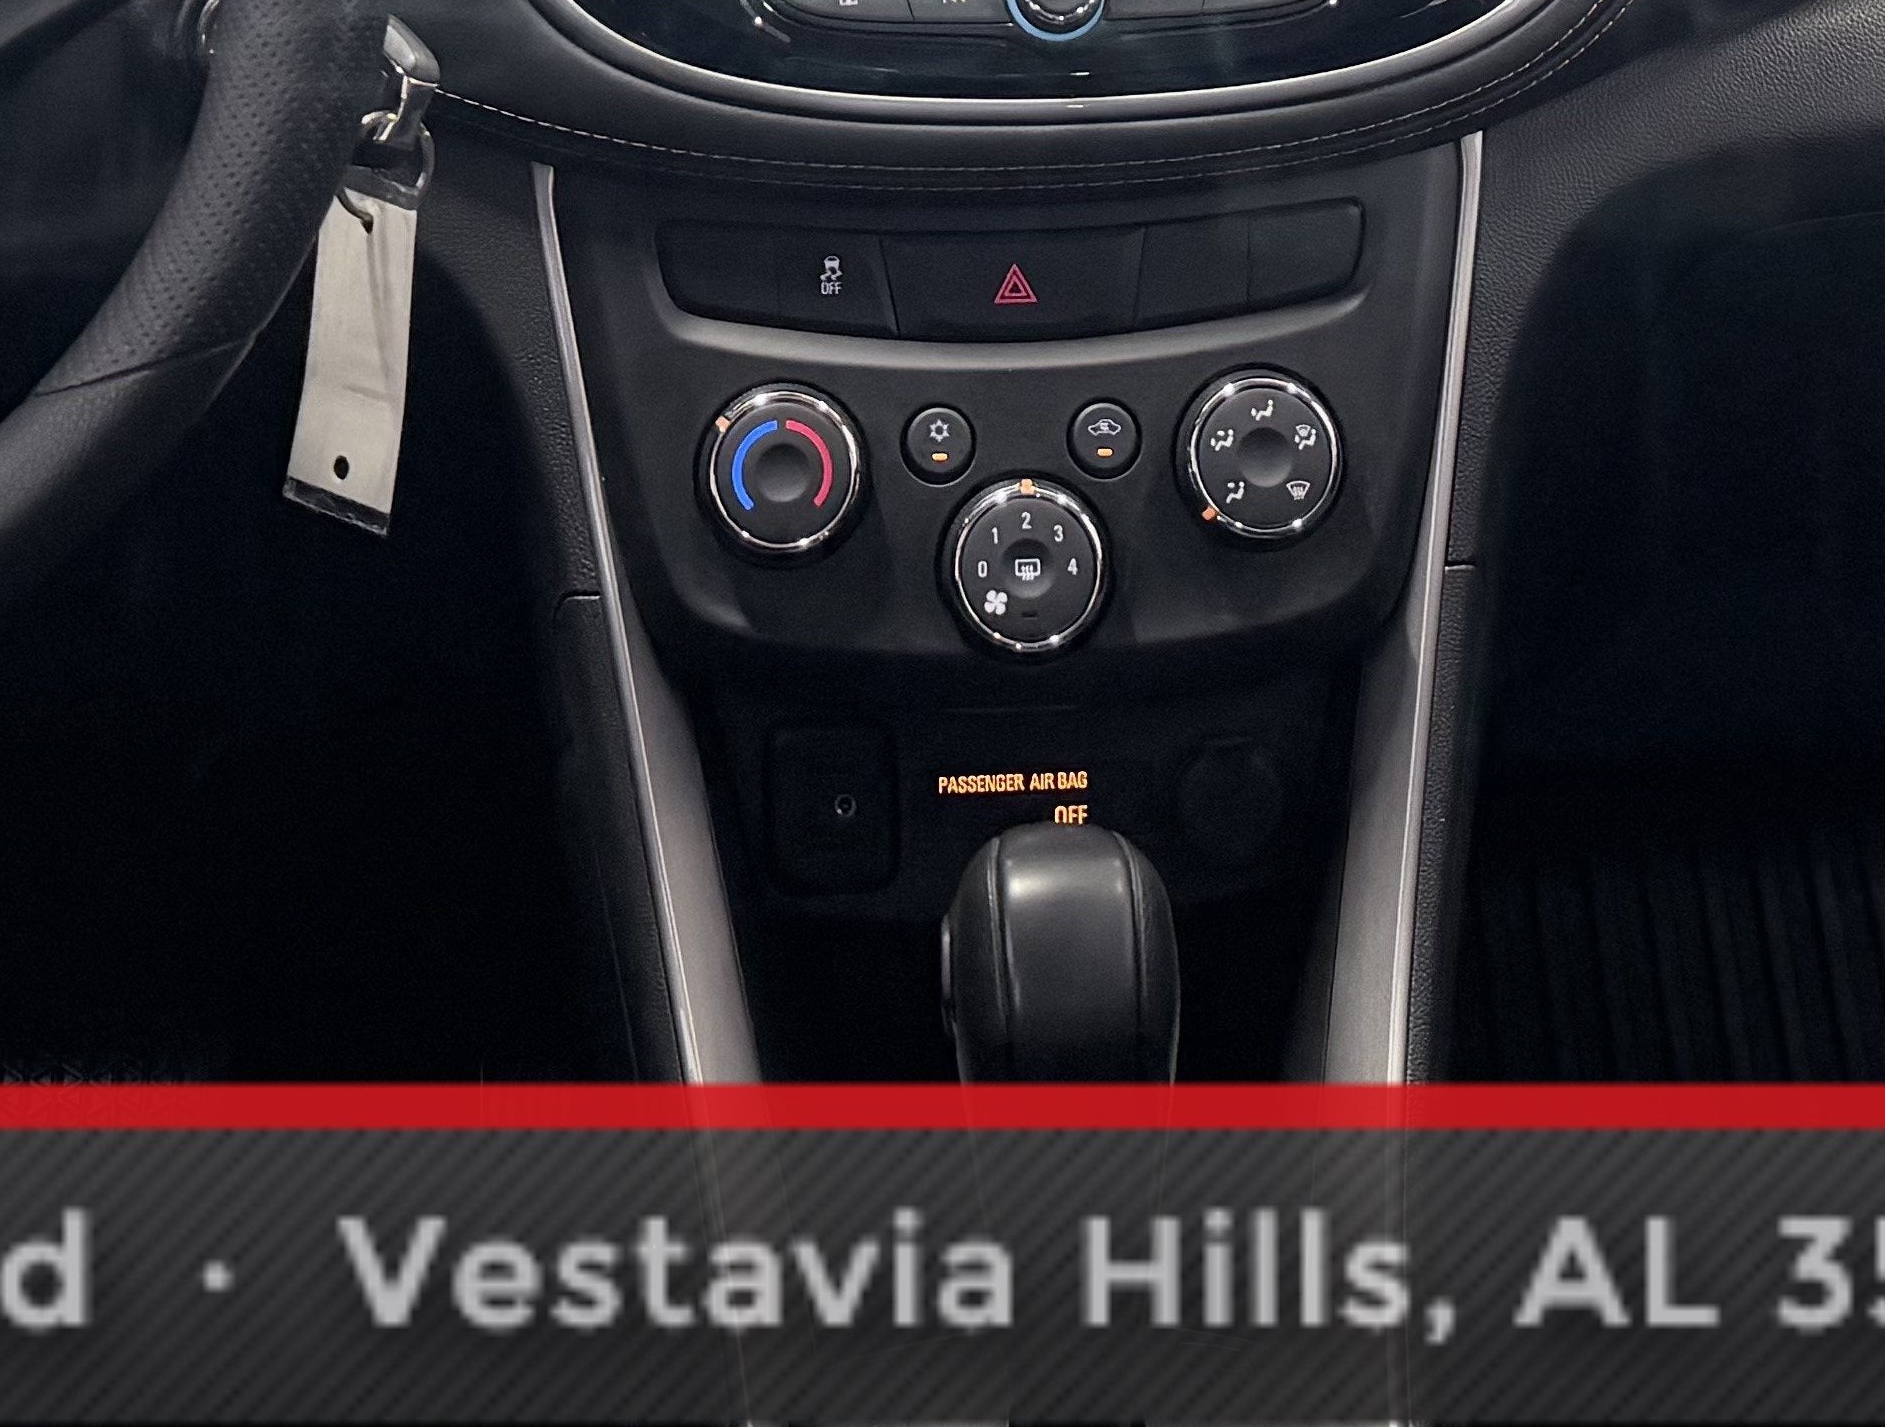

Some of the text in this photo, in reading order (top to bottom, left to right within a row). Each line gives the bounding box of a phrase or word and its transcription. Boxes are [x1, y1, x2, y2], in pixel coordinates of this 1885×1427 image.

[820, 278, 843, 295] OFF
[1020, 512, 1032, 530] 2
[992, 528, 999, 544] 1
[1054, 526, 1064, 543] 3
[977, 561, 988, 578] 0
[1067, 558, 1078, 575] 4
[937, 770, 1088, 794] PASSENGER AIR BAG
[1054, 806, 1088, 824] OFF
